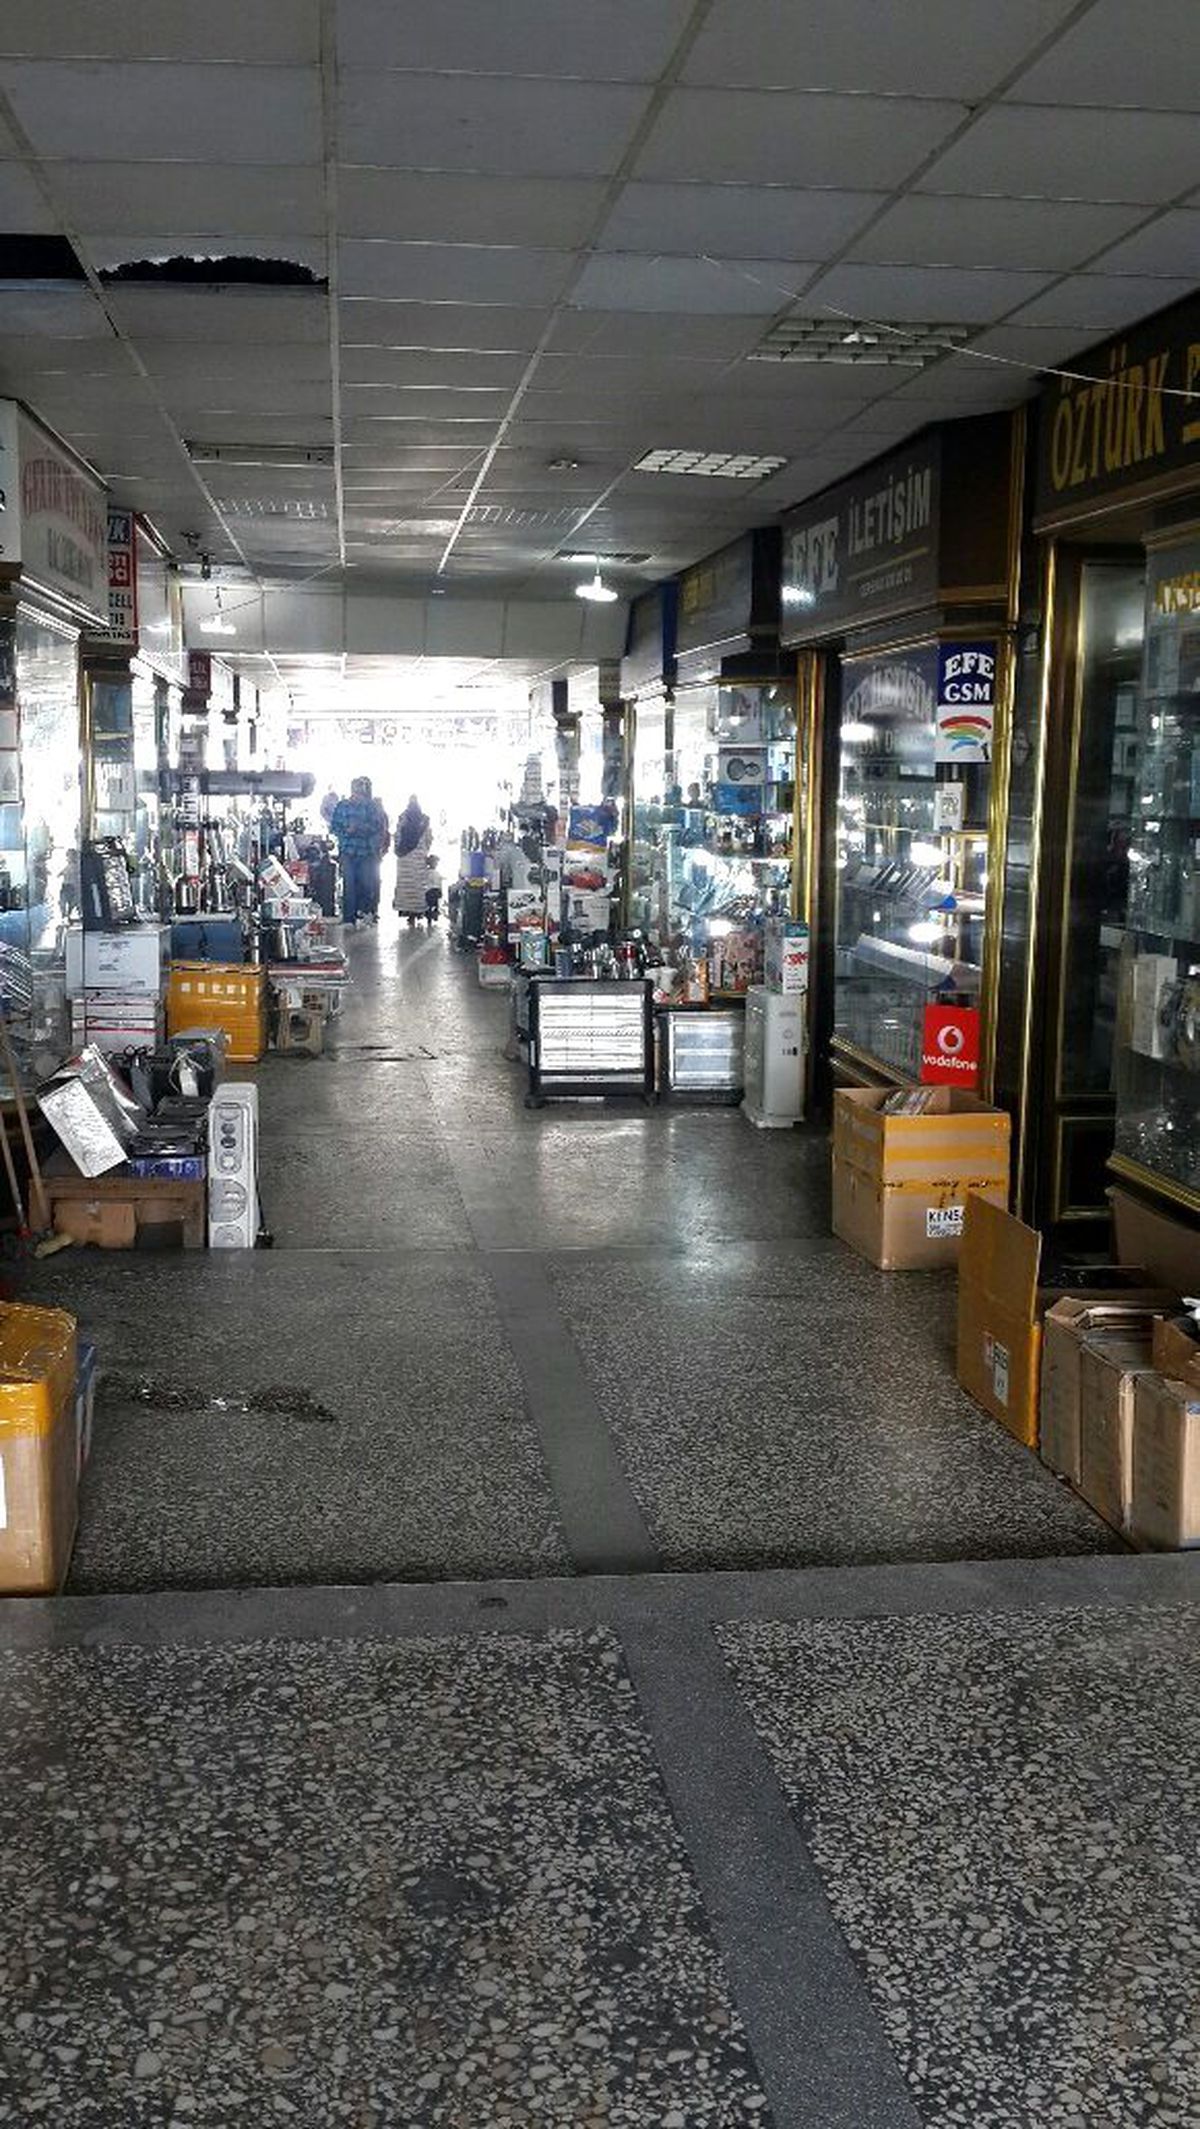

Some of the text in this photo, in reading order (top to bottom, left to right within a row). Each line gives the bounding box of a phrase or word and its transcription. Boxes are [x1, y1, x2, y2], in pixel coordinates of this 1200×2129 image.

[1051, 343, 1170, 492] ÖZTÜRK
[848, 465, 931, 557] İLETİŞİM
[944, 651, 995, 682] EFE
[944, 682, 991, 702] GSM
[922, 1054, 978, 1071] vodafone
